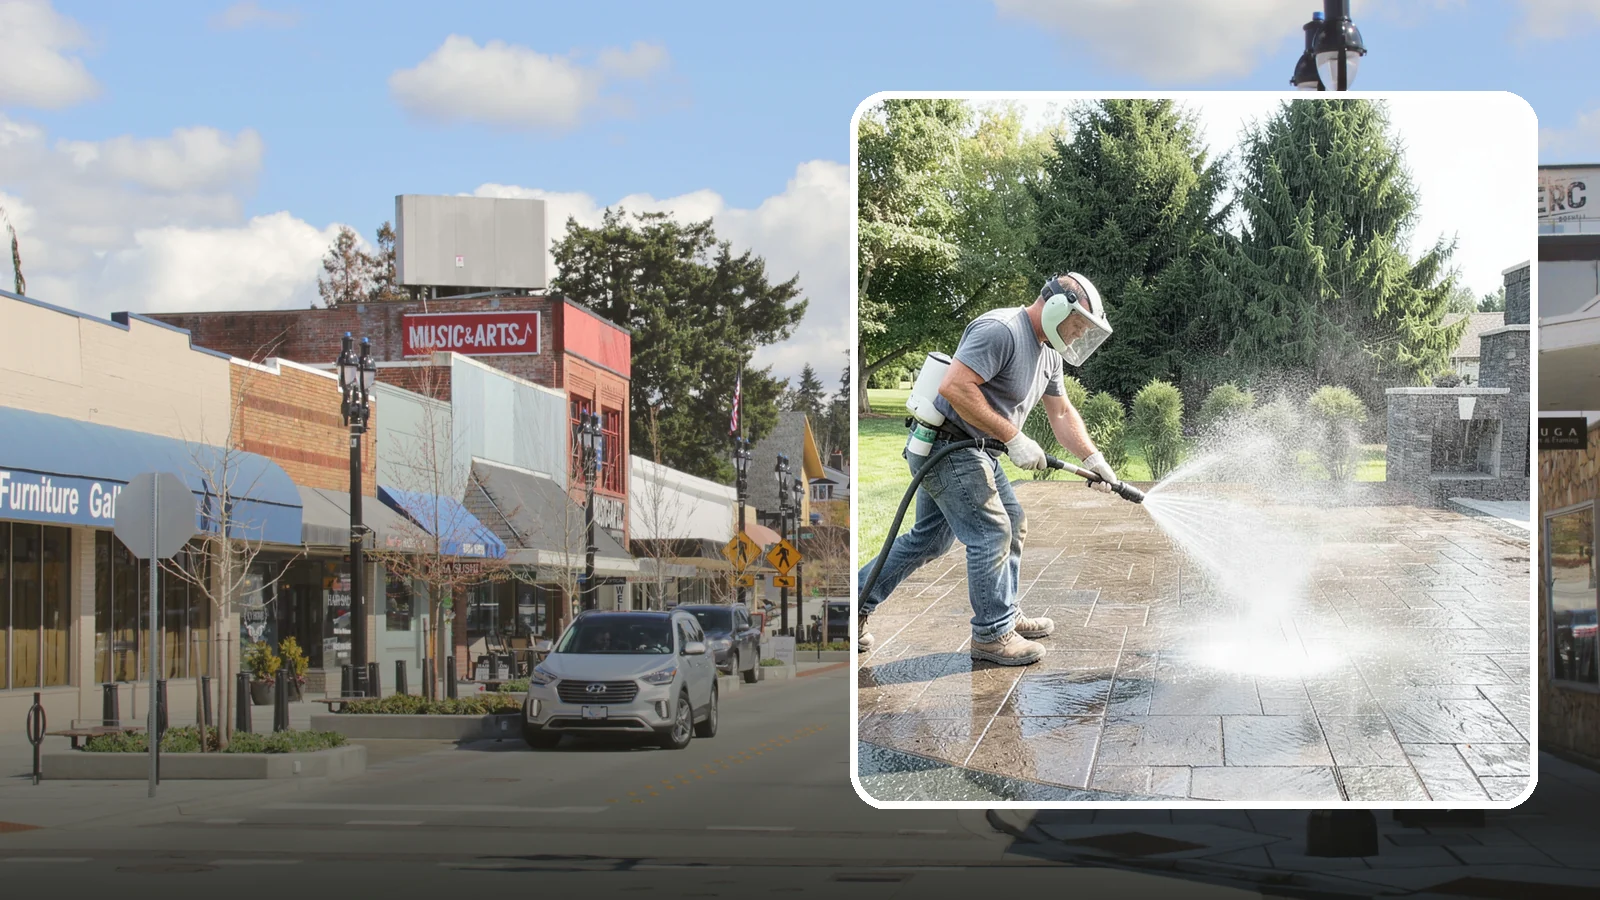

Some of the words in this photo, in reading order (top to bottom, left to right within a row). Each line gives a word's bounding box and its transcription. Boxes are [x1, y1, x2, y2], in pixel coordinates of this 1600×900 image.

[409, 322, 520, 349] MUSIC&ARTS
[0, 471, 79, 515] Furniture
[89, 482, 122, 519] Gal
